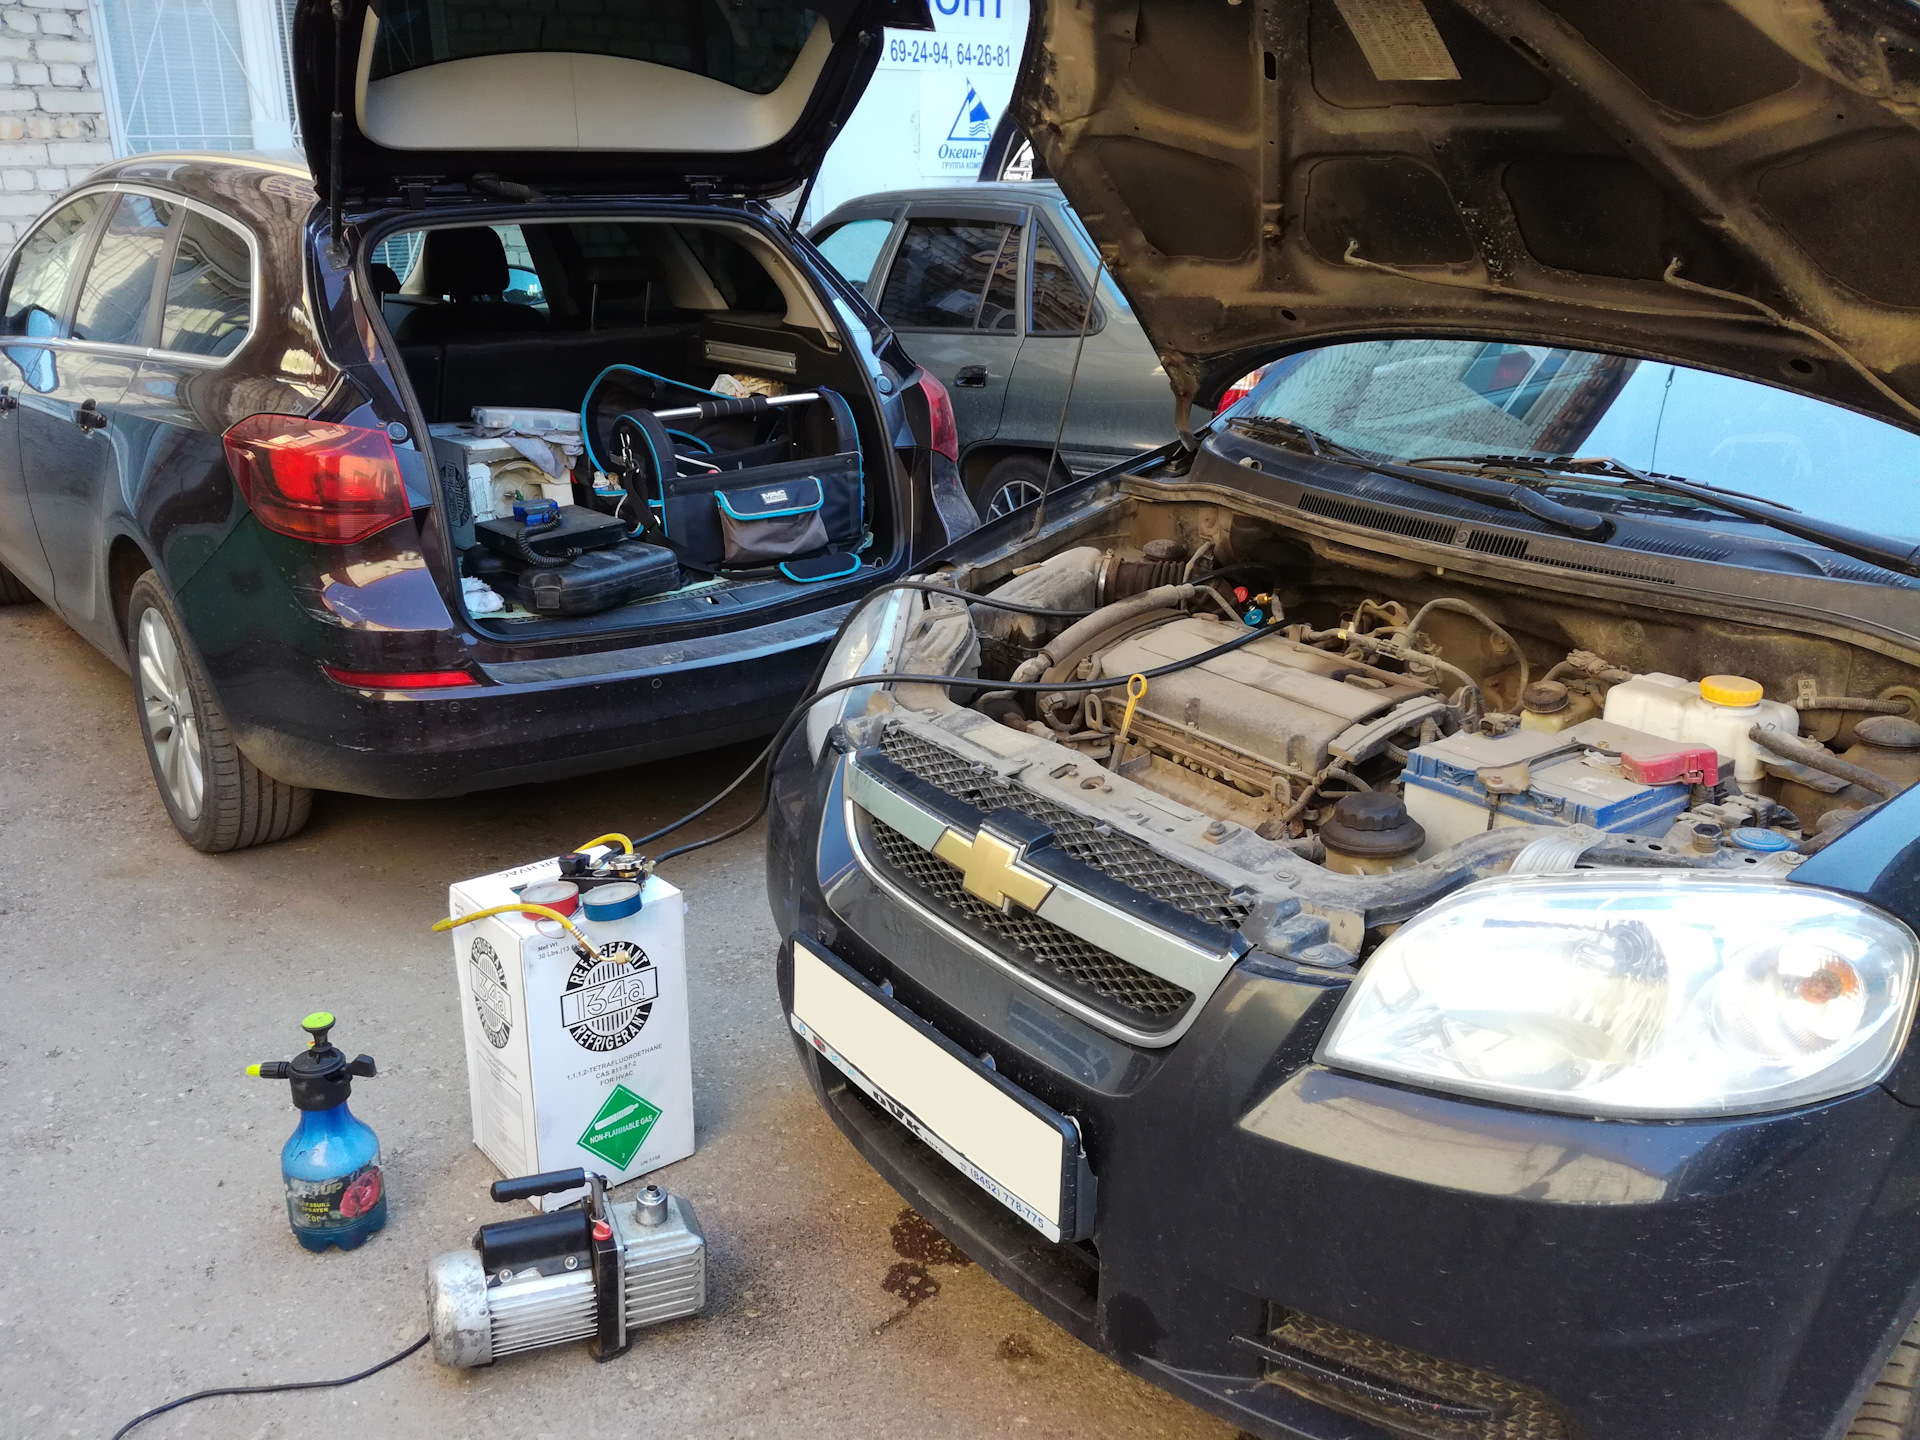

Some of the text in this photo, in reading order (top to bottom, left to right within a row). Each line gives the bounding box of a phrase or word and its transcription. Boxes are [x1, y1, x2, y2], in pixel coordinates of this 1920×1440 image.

[890, 39, 1010, 68] 69-24-94, 64-26-81
[942, 161, 965, 169] ГРУППА
[498, 859, 559, 879] OR HVAC
[570, 942, 648, 984] REFGERANT
[577, 979, 645, 1021] 134a
[572, 1008, 649, 1051] REFRIGERANT
[595, 1069, 610, 1079] CAS
[600, 1070, 634, 1086] FOR HVAC
[589, 1114, 653, 1144] NON-FLAMMABLE GAS
[970, 1168, 1045, 1229] (8452) 778-775
